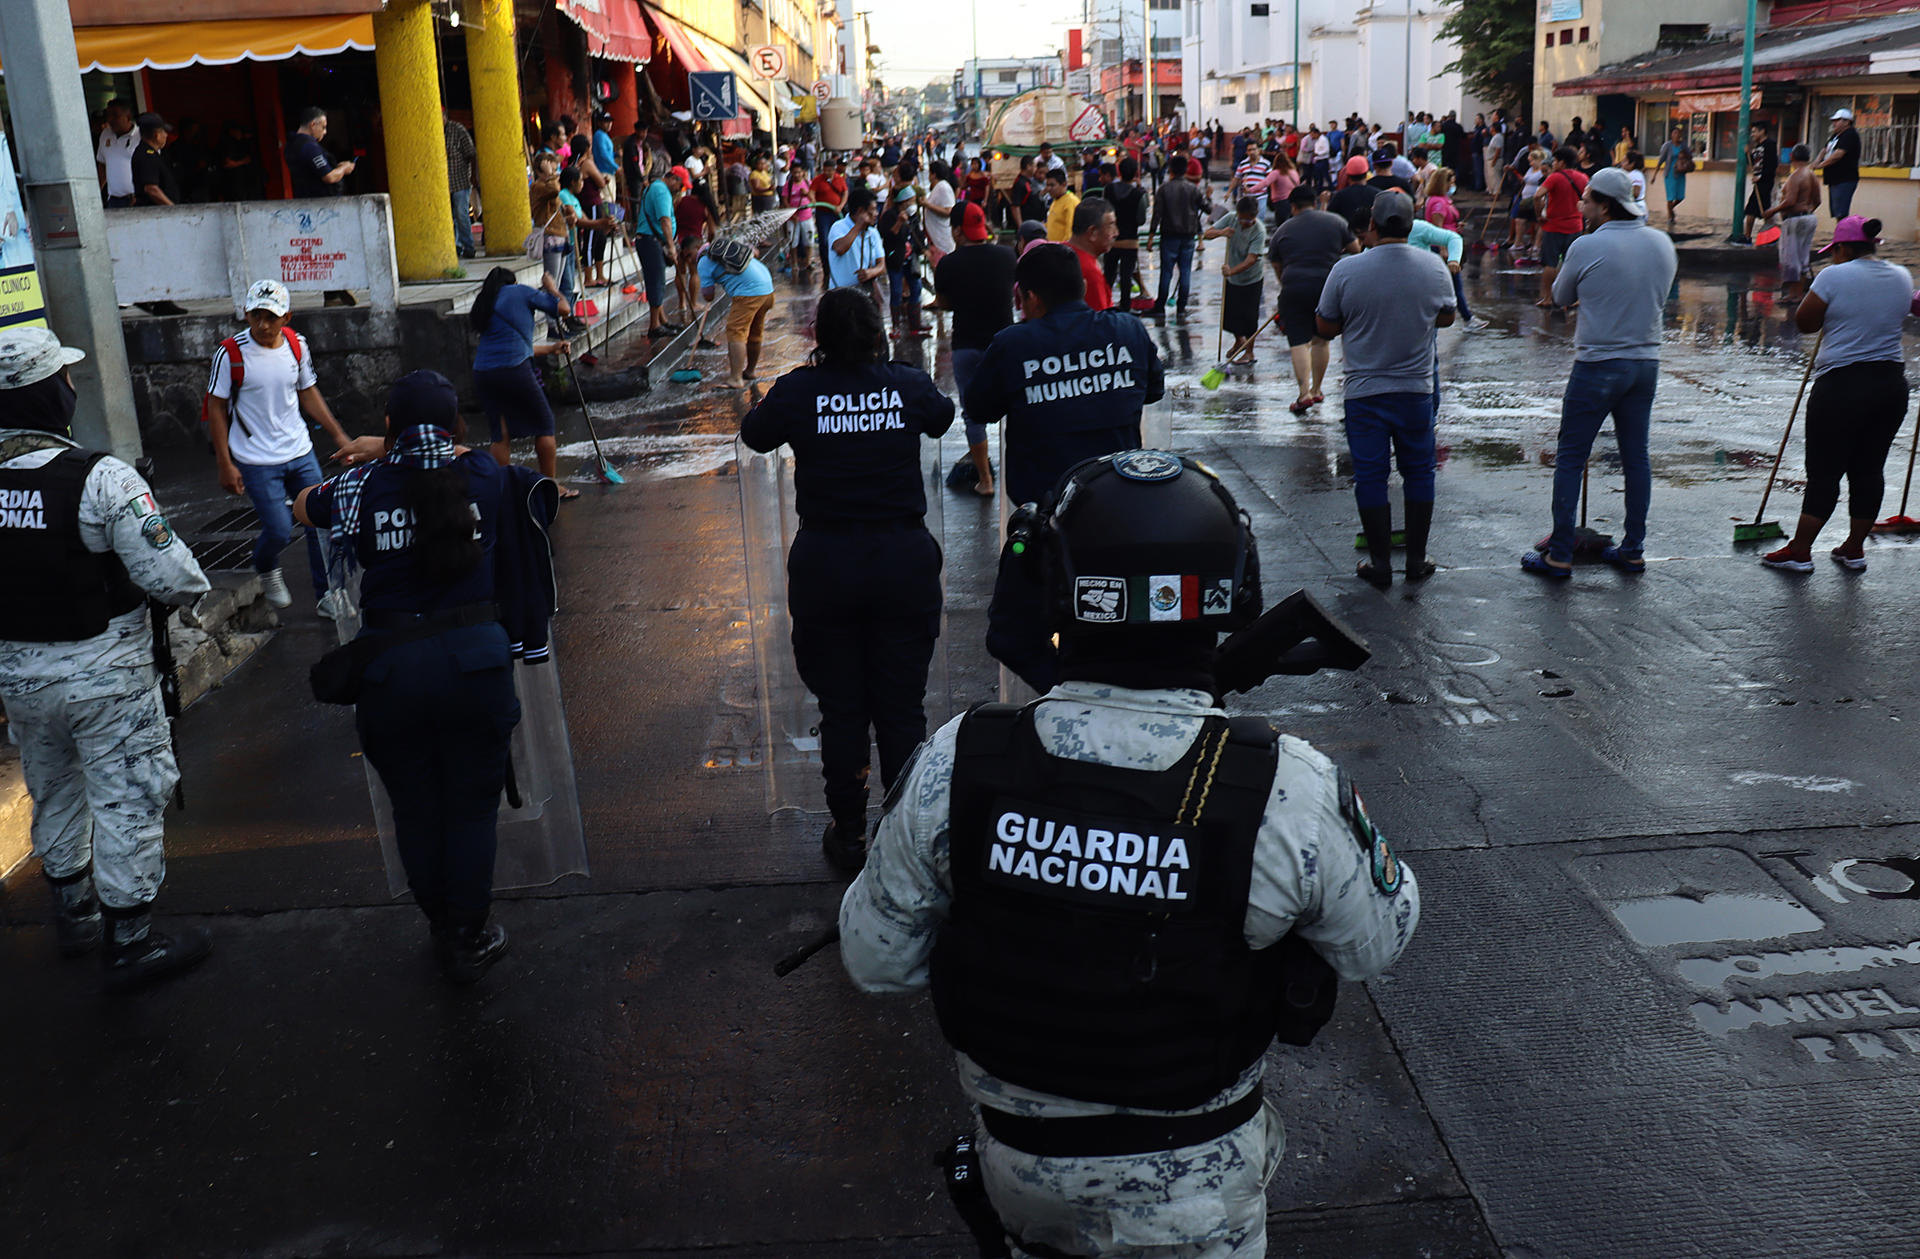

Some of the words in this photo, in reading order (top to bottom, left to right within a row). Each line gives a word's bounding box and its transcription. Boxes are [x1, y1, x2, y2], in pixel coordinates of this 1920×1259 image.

[1023, 343, 1134, 379] POLICÍA
[816, 387, 904, 414] POLICÍA
[1024, 369, 1136, 404] MUNICIPAL
[817, 411, 905, 434] MUNICIPAL
[1079, 579, 1107, 588] HECHO
[1109, 581, 1122, 589] EN
[996, 812, 1190, 869] GUARDIA
[989, 843, 1187, 900] NACIONAL
